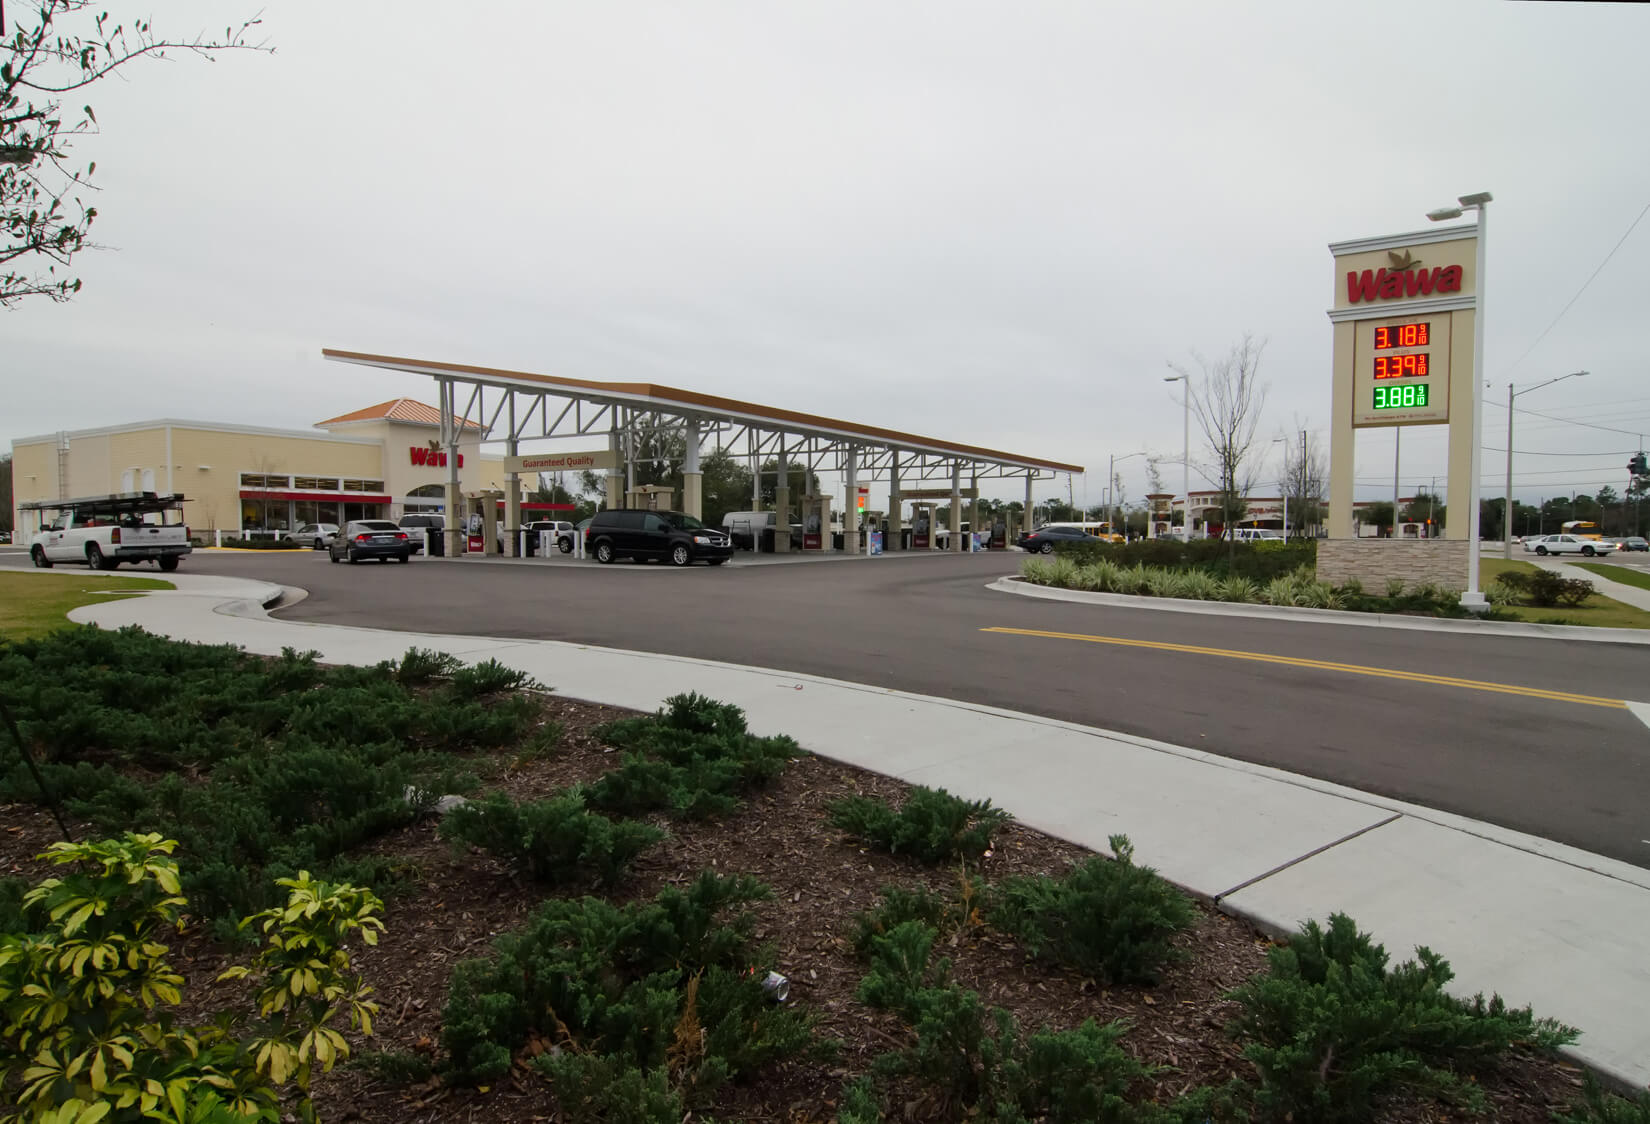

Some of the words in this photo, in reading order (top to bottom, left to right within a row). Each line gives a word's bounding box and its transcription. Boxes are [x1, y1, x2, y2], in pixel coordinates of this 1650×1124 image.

[1346, 264, 1463, 304] Wawa
[1377, 325, 1417, 348] 3.18
[1376, 355, 1416, 378] 3.39
[1375, 386, 1415, 408] 3.88
[522, 457, 565, 468] Guaranteed
[566, 455, 595, 467] Quality
